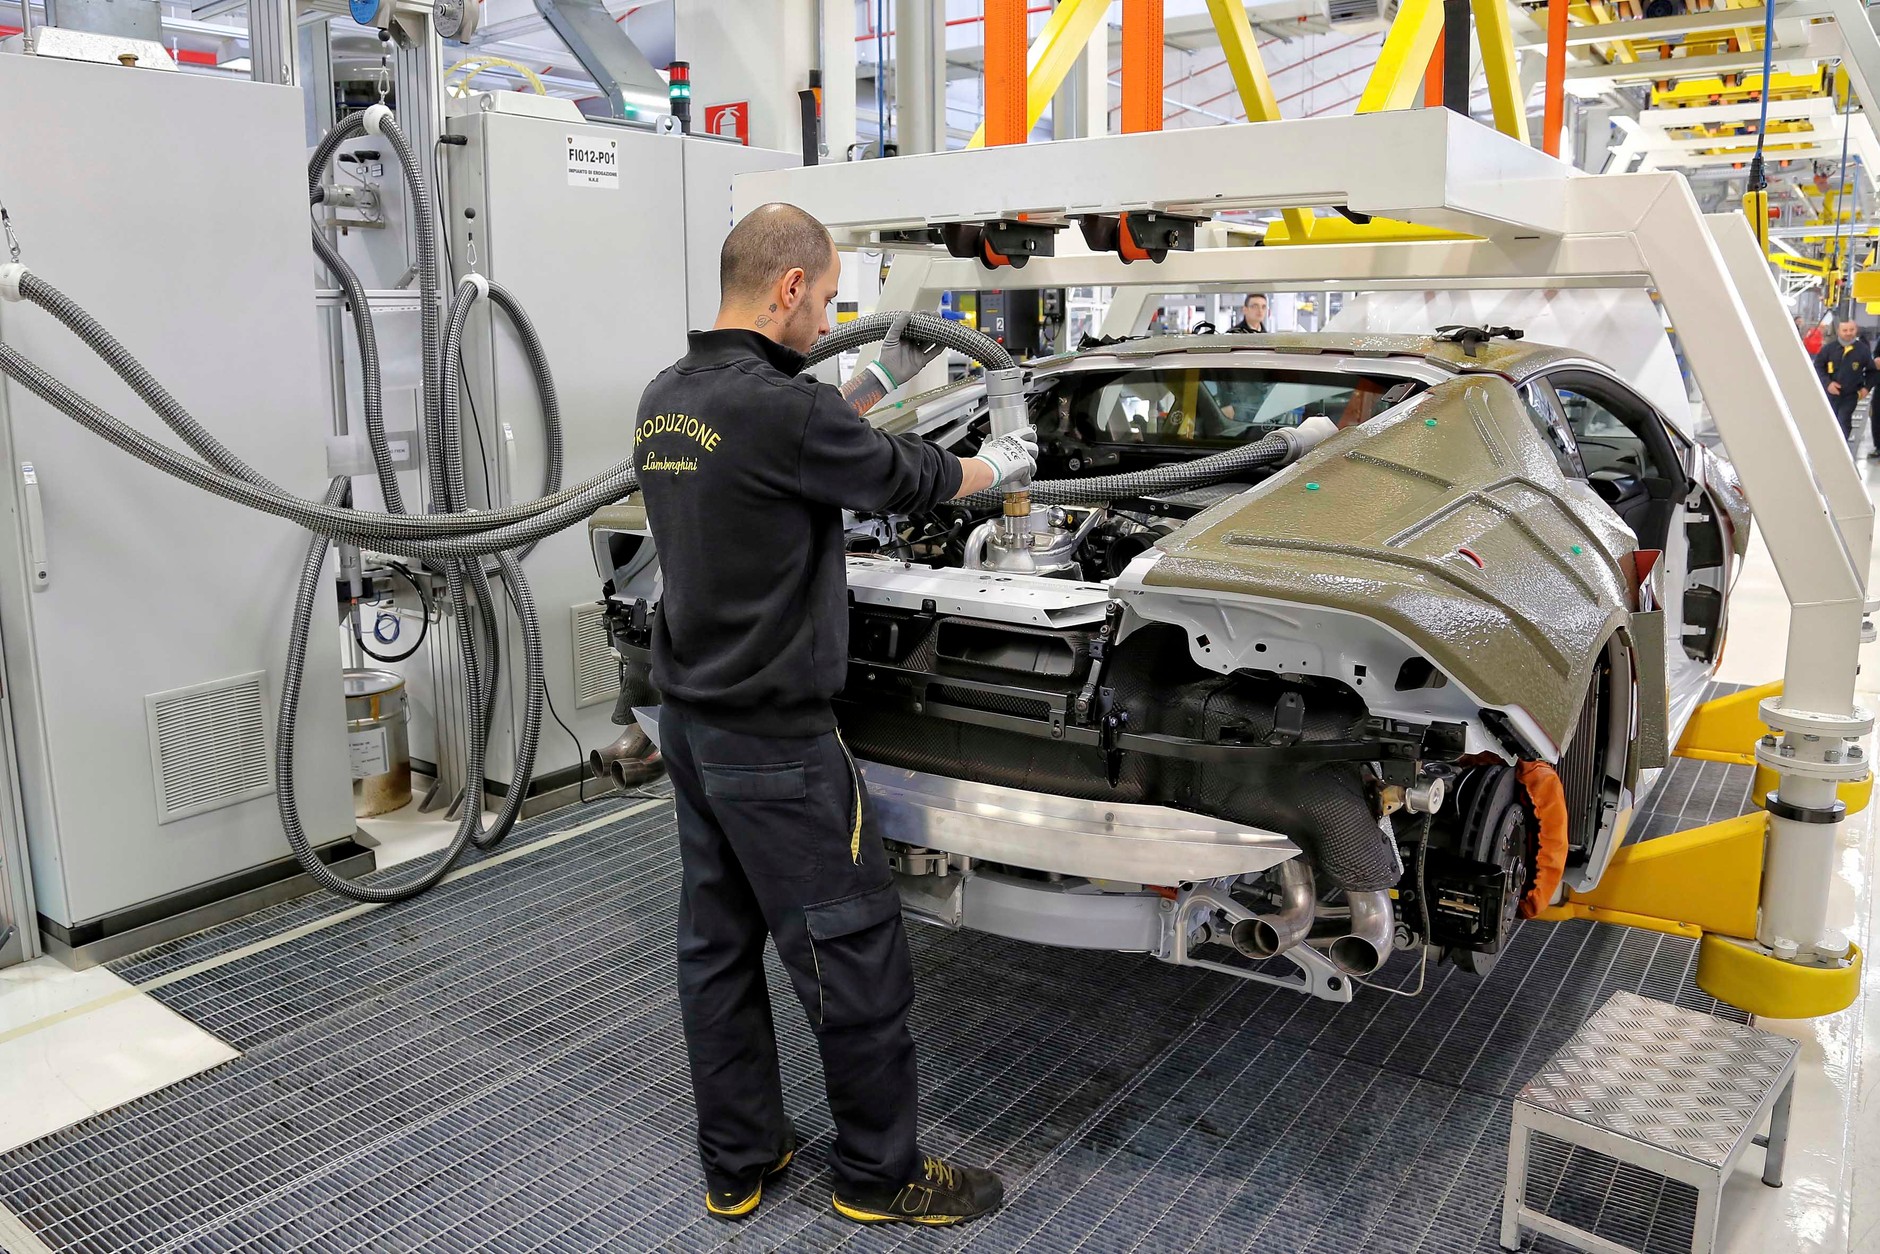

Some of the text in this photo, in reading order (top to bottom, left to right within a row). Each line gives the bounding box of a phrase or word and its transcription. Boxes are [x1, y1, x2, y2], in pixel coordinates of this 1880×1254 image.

[569, 148, 615, 165] FI012-P01
[997, 319, 1003, 330] 2
[634, 413, 722, 452] RODUZIONE
[642, 451, 698, 475] Lamborghini
